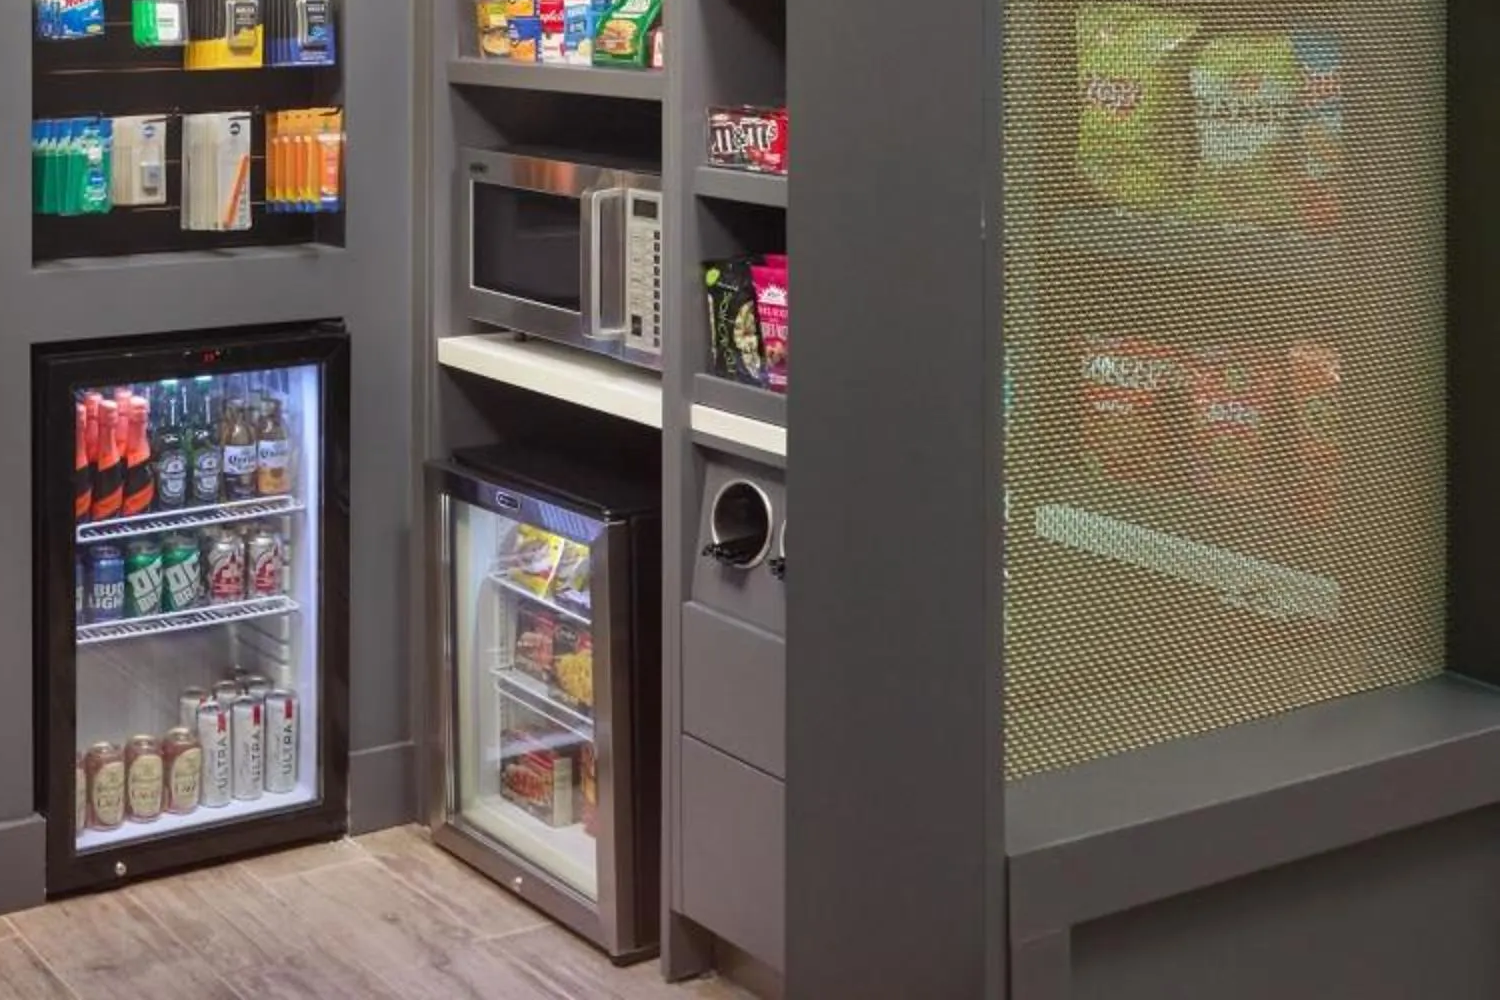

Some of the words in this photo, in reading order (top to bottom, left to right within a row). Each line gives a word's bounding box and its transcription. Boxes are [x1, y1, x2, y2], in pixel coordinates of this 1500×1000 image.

[89, 594, 124, 609] LIGH
[217, 737, 229, 790] ULTRA
[252, 730, 261, 783] ULTRA
[283, 724, 293, 775] ULTRA
